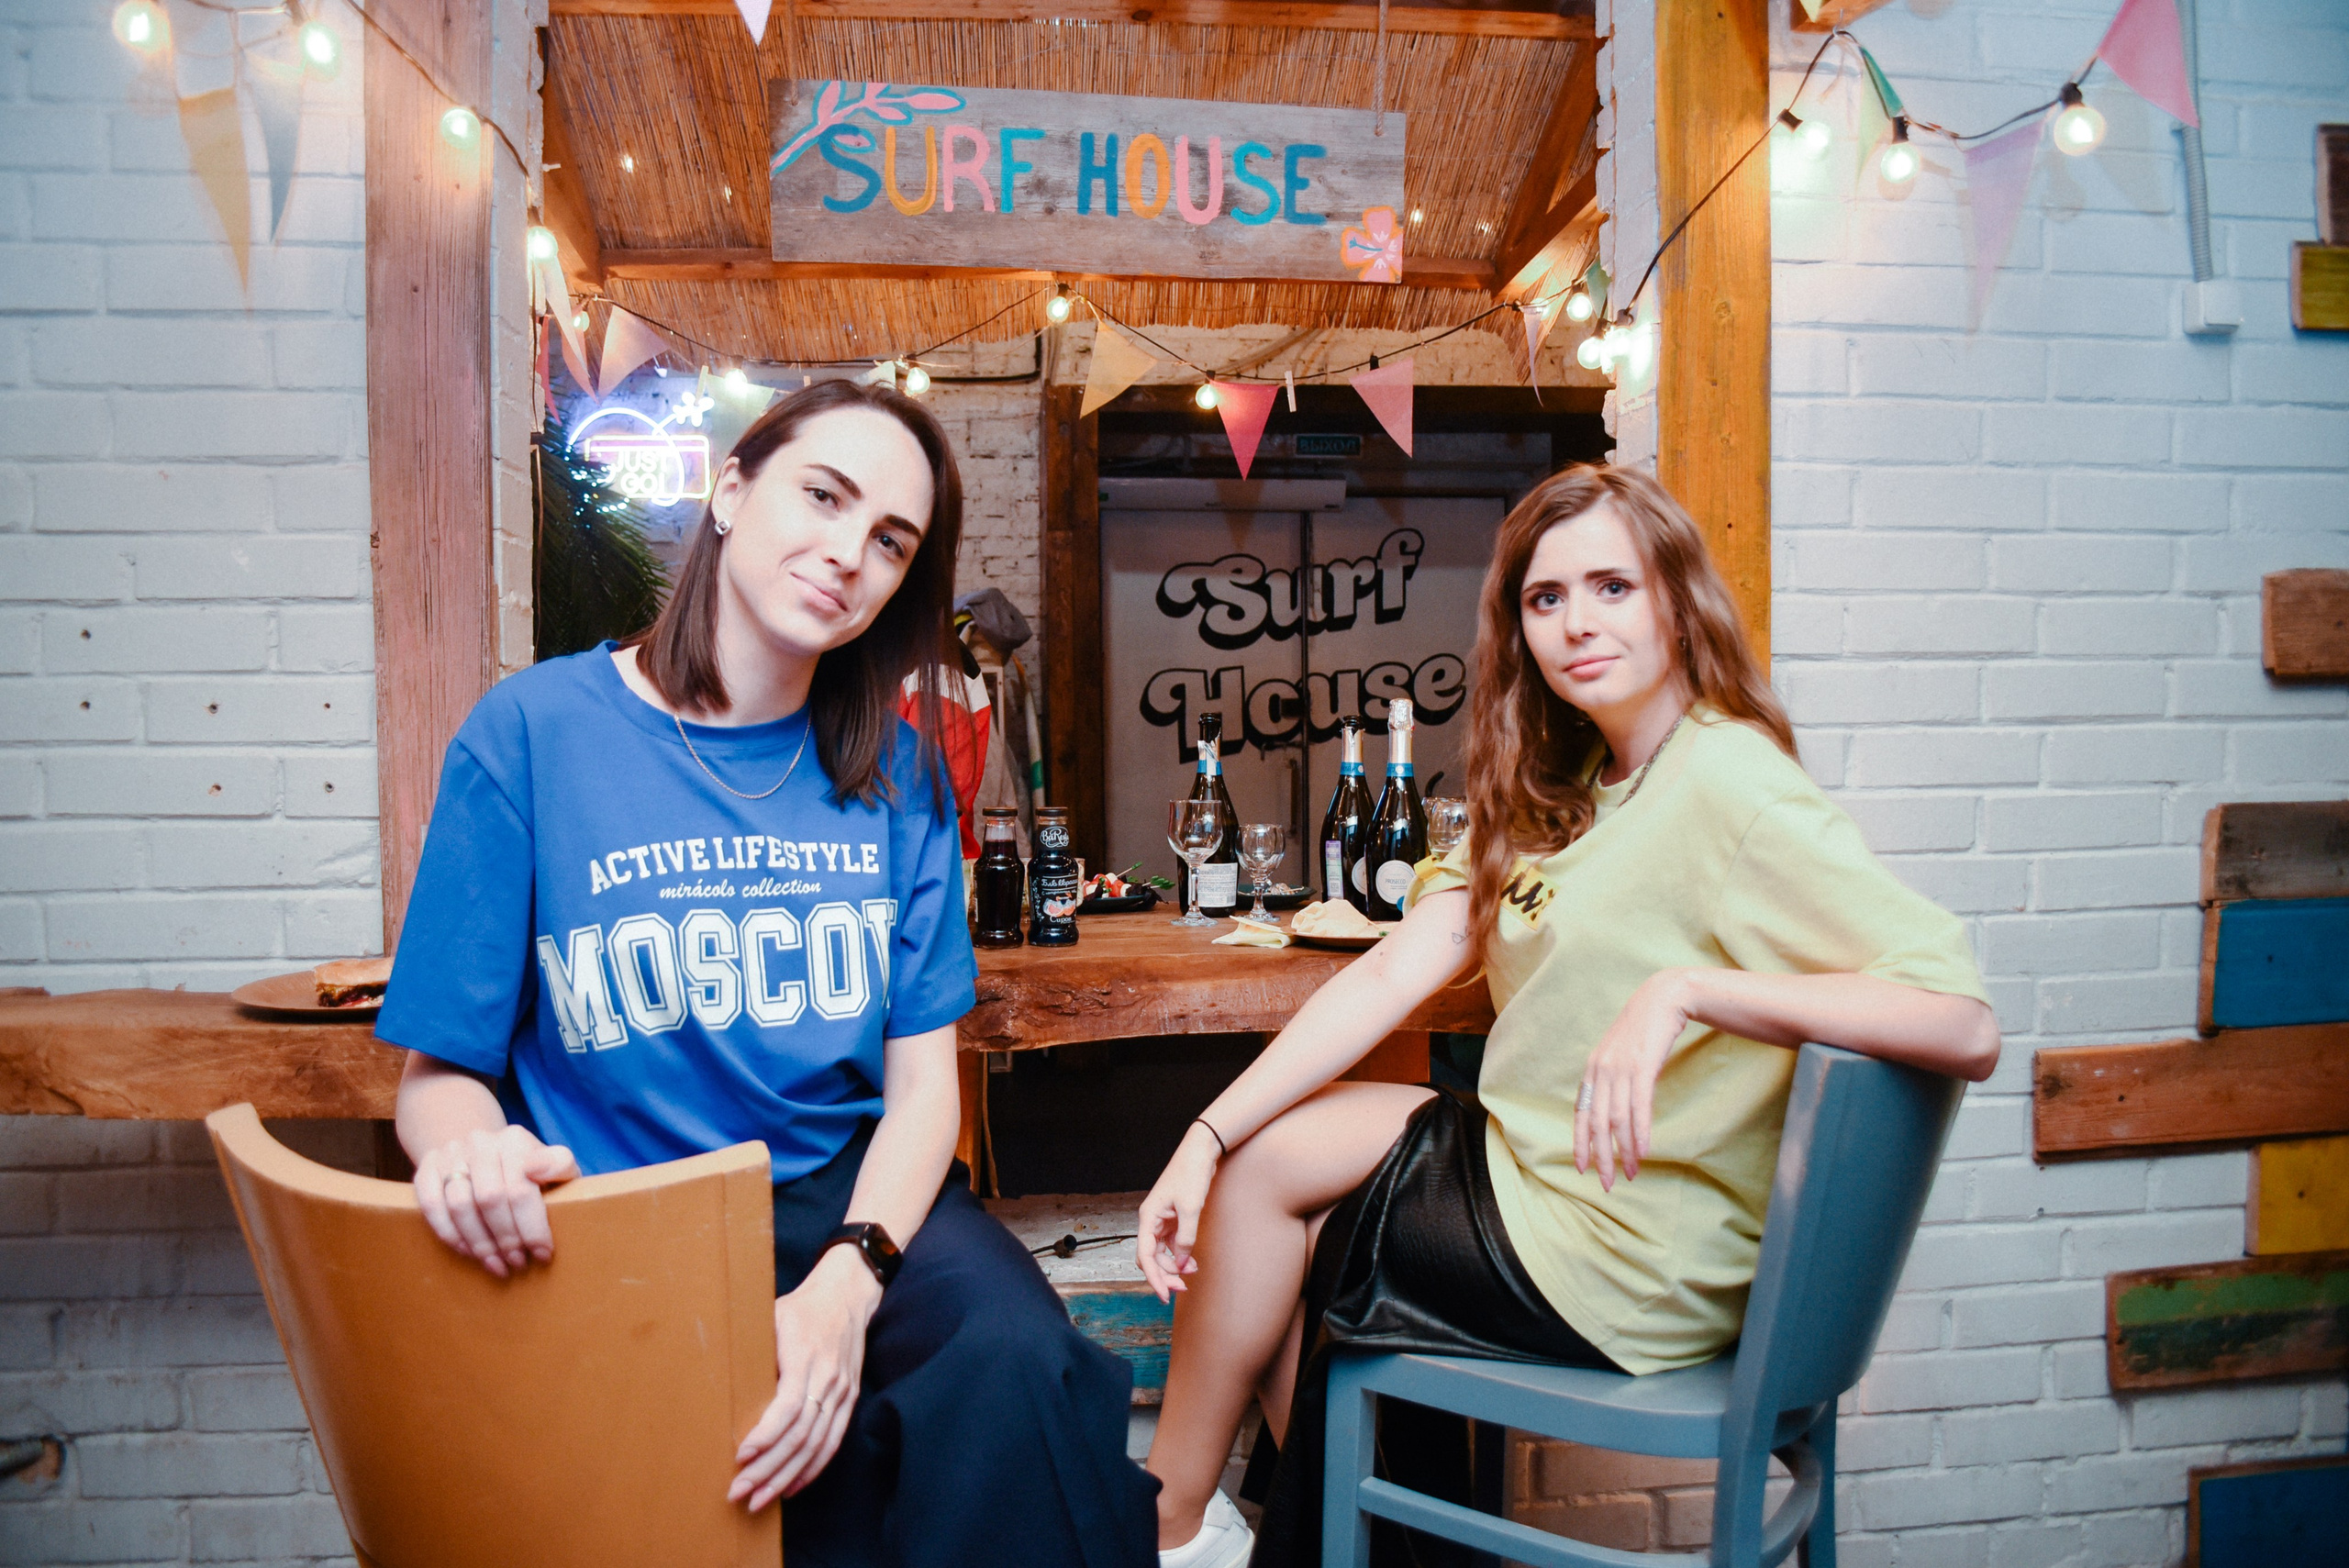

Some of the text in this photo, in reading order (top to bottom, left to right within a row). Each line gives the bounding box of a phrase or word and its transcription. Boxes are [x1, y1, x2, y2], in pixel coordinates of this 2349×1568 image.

[820, 122, 1328, 227] SURF HOUSE
[615, 448, 670, 473] JUST
[1155, 528, 1425, 651] Surf
[1140, 653, 1467, 764] House
[590, 835, 881, 895] ACTIVE LIFESTYLE
[659, 877, 822, 900] mirácolo collection
